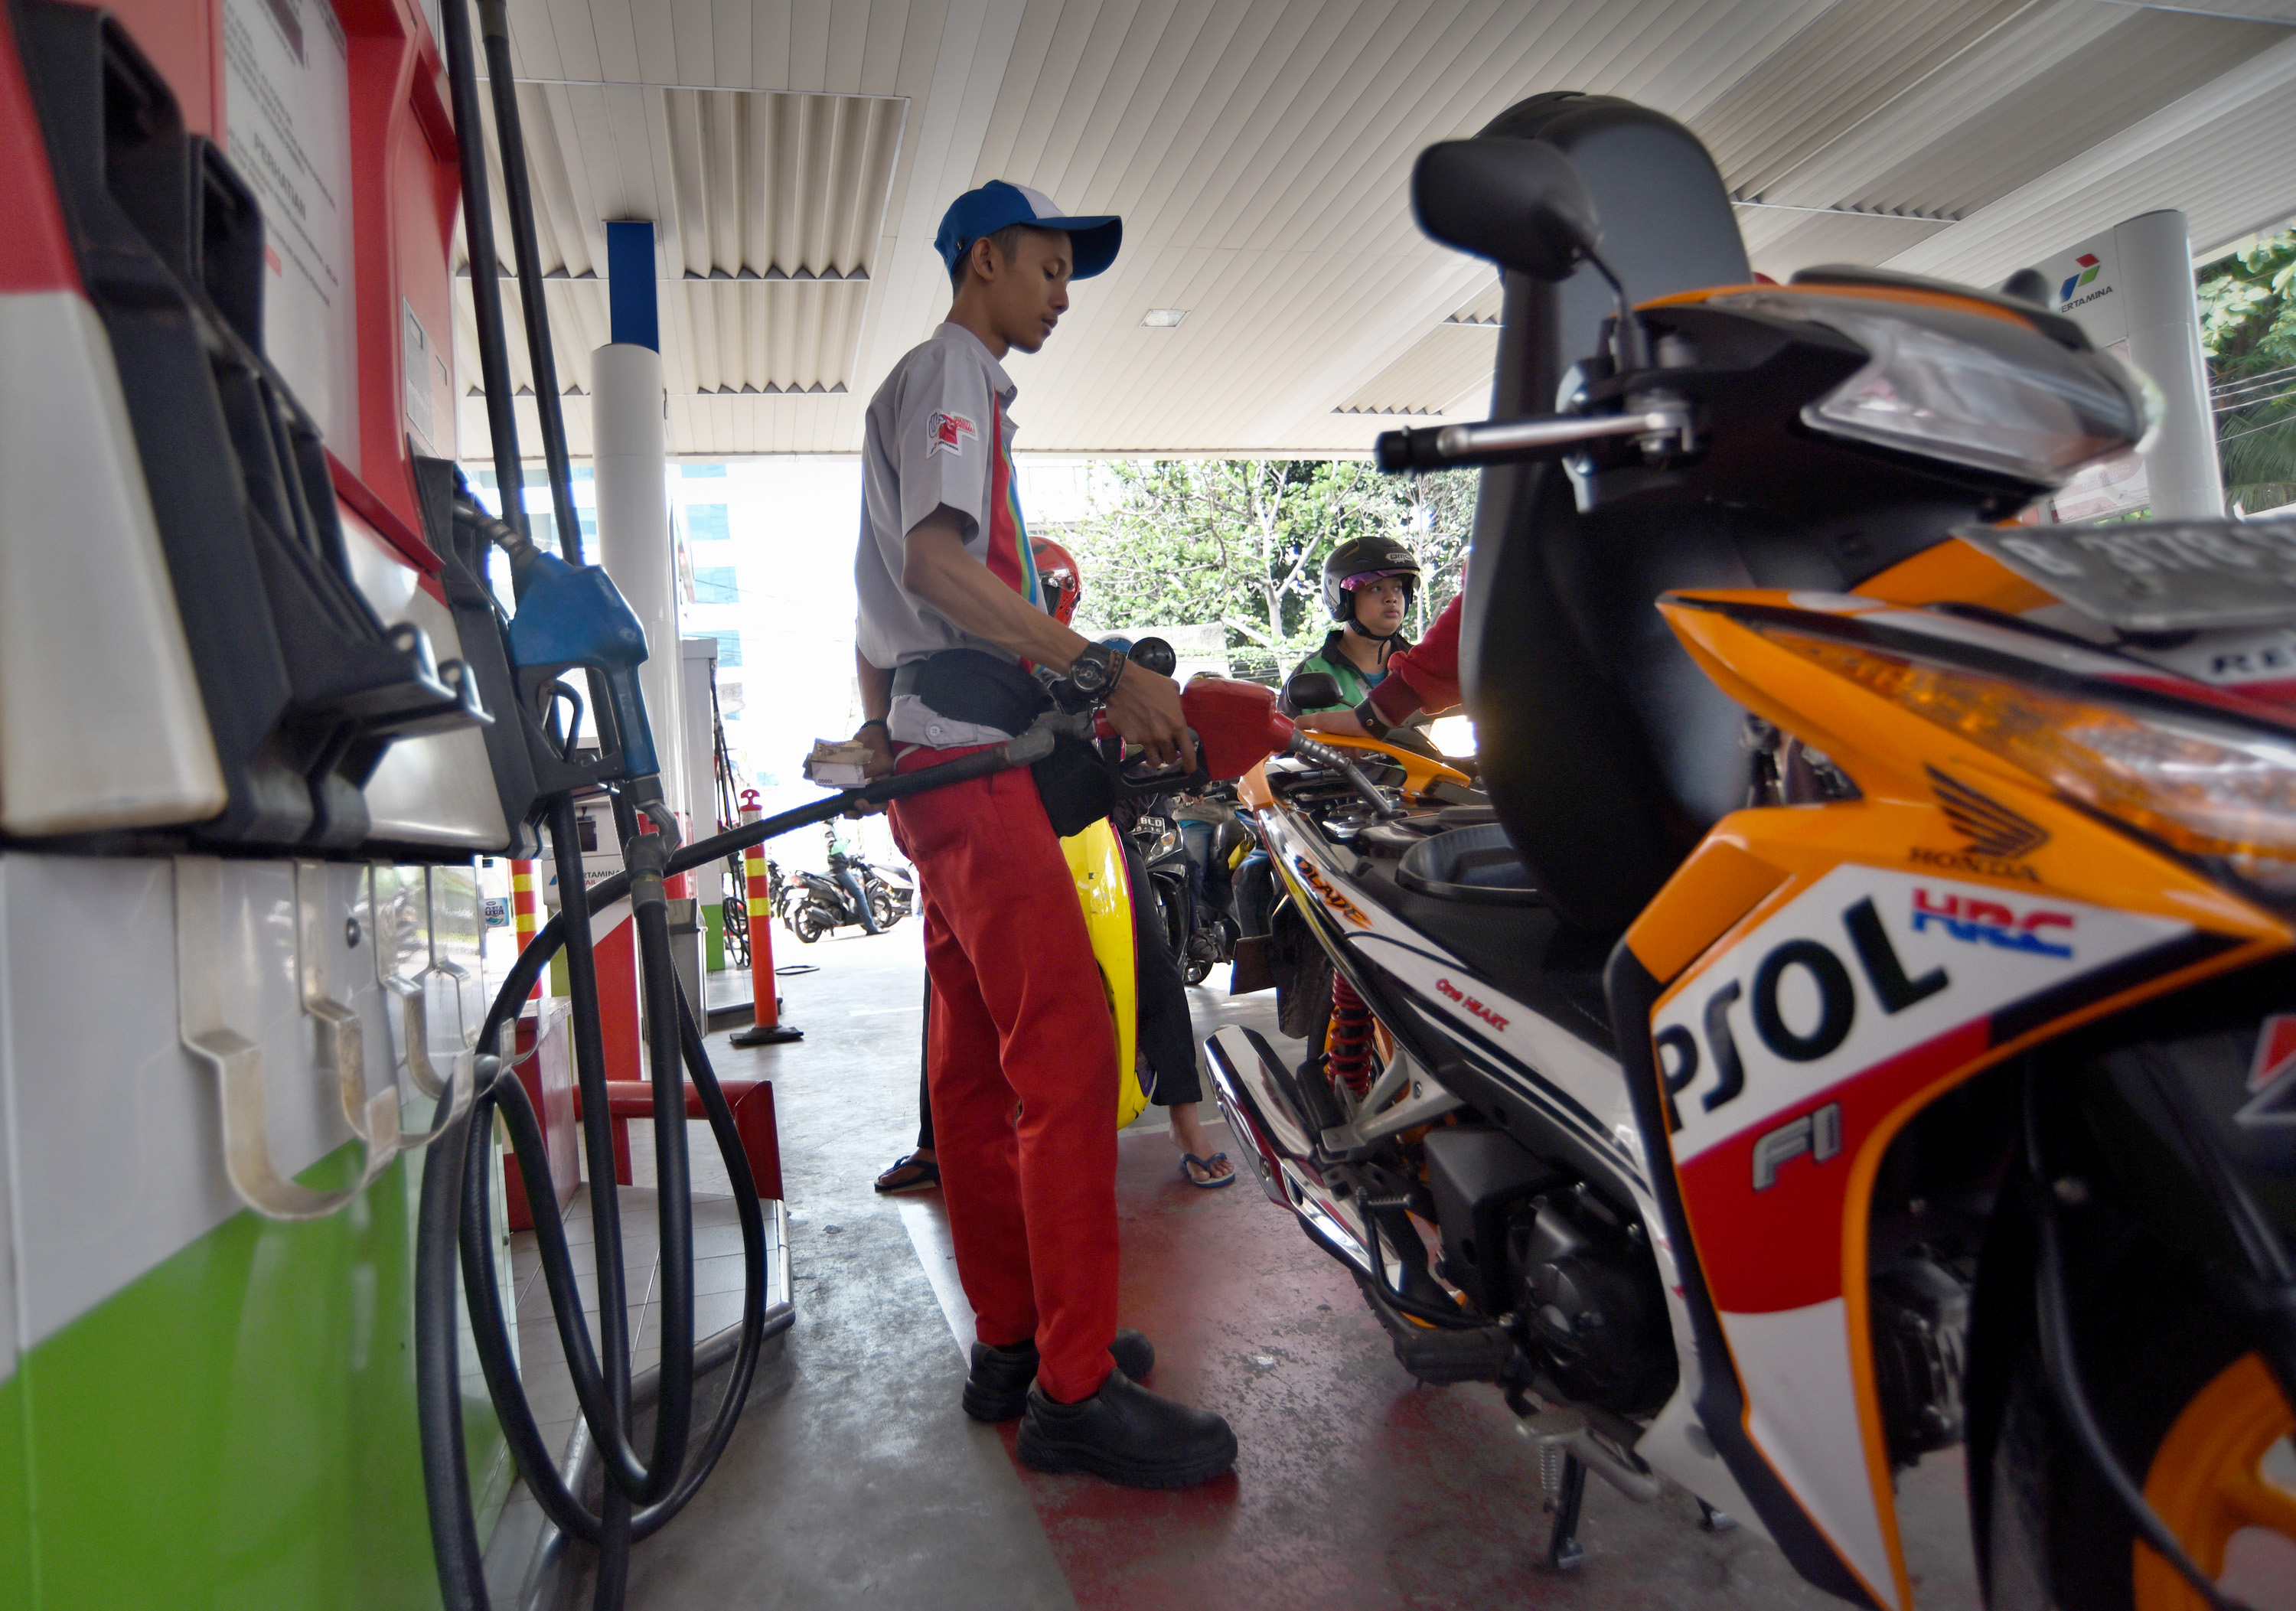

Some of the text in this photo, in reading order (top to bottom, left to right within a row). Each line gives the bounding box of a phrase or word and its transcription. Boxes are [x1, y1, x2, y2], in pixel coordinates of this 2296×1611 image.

[254, 132, 306, 220] PERHATIAN
[2059, 286, 2113, 313] ERTAMINA
[2210, 648, 2296, 675] RE
[1140, 817, 1163, 827] BLD
[583, 870, 620, 879] RTAMIN
[1909, 846, 2043, 883] HONDA
[484, 905, 505, 917] QUA
[1295, 848, 1373, 931] BLADE
[1913, 889, 2073, 959] HRC
[1436, 978, 1509, 1032] One HEART
[1655, 895, 1949, 1133] PSOL
[1753, 1101, 1842, 1191] FI
